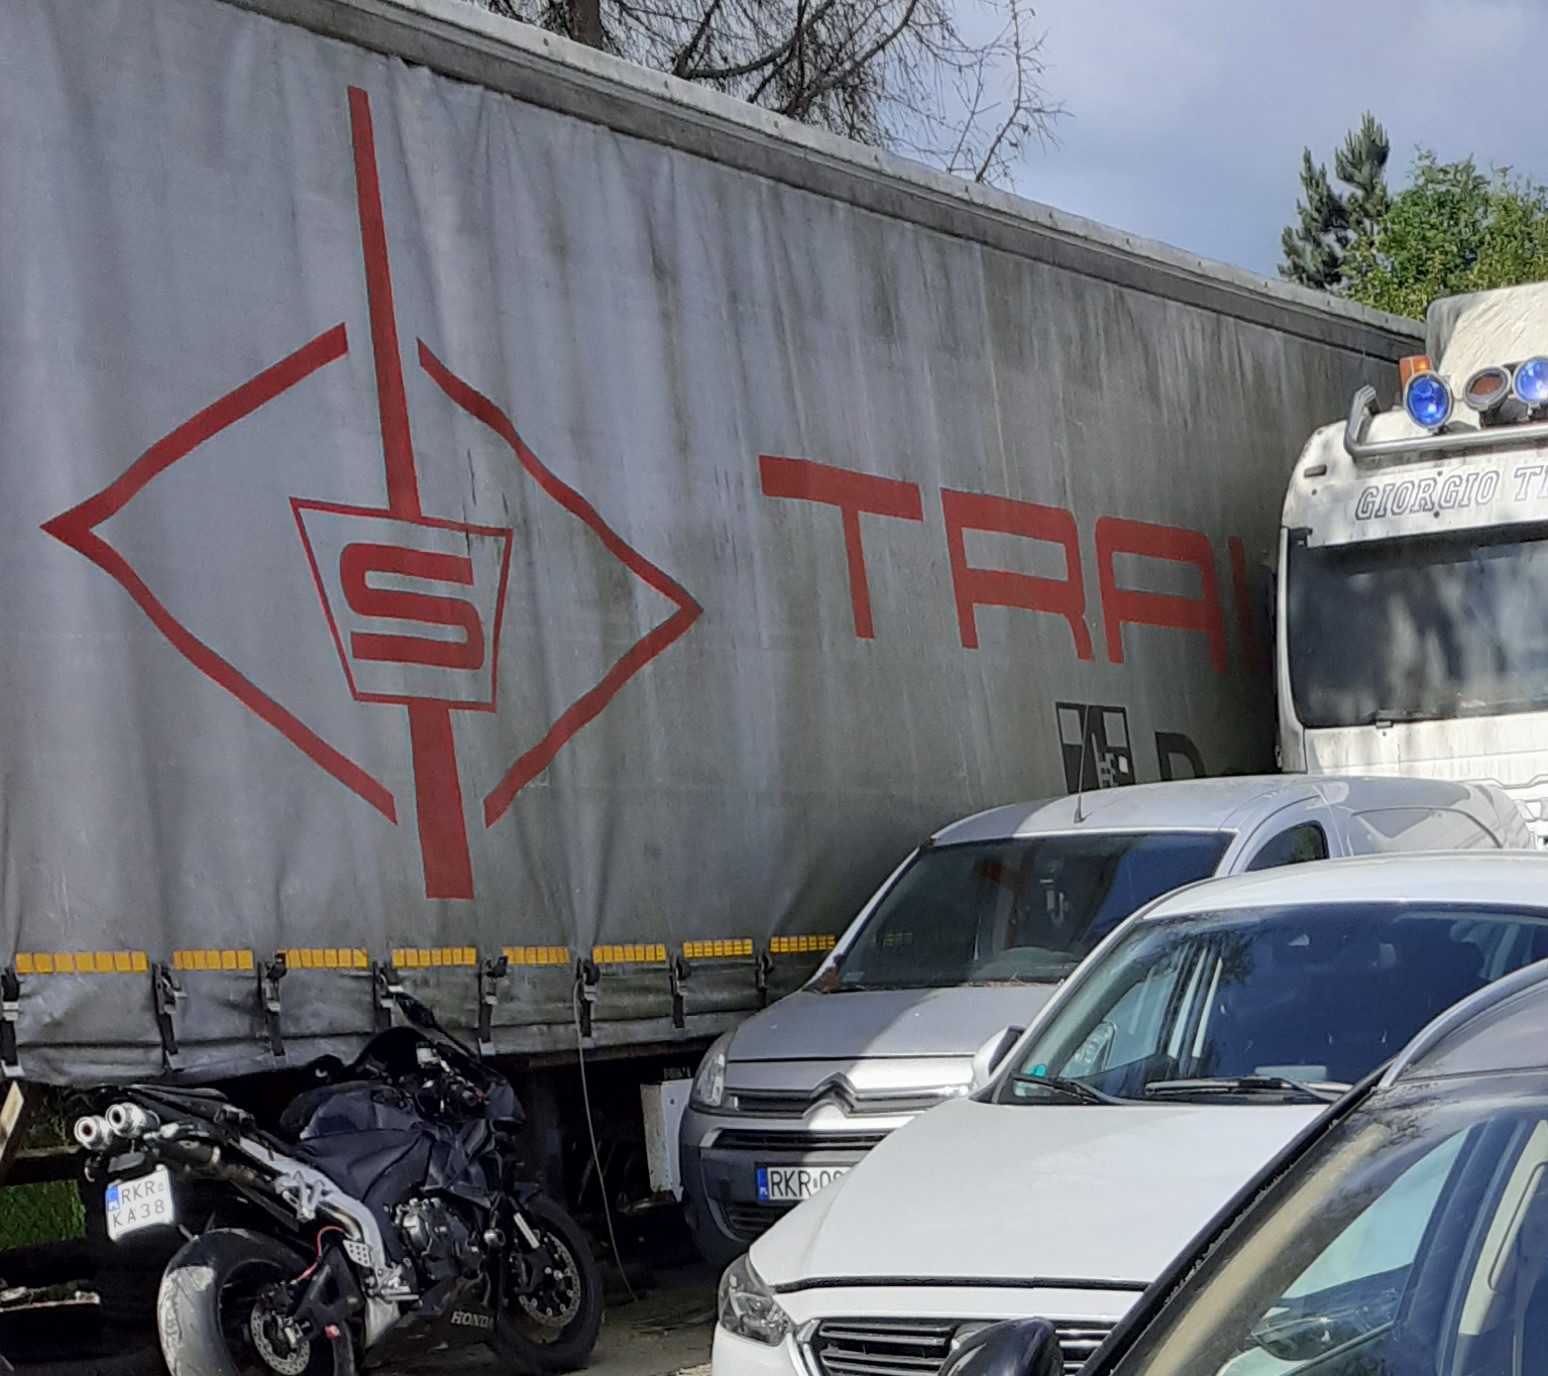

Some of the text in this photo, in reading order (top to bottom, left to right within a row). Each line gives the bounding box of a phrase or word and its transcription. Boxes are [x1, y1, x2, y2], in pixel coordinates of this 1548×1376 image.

[1355, 470, 1500, 521] GIORGIO
[340, 543, 485, 670] S
[121, 1180, 155, 1205] RKR
[770, 1170, 812, 1197] RKR
[112, 1199, 165, 1228] KA38
